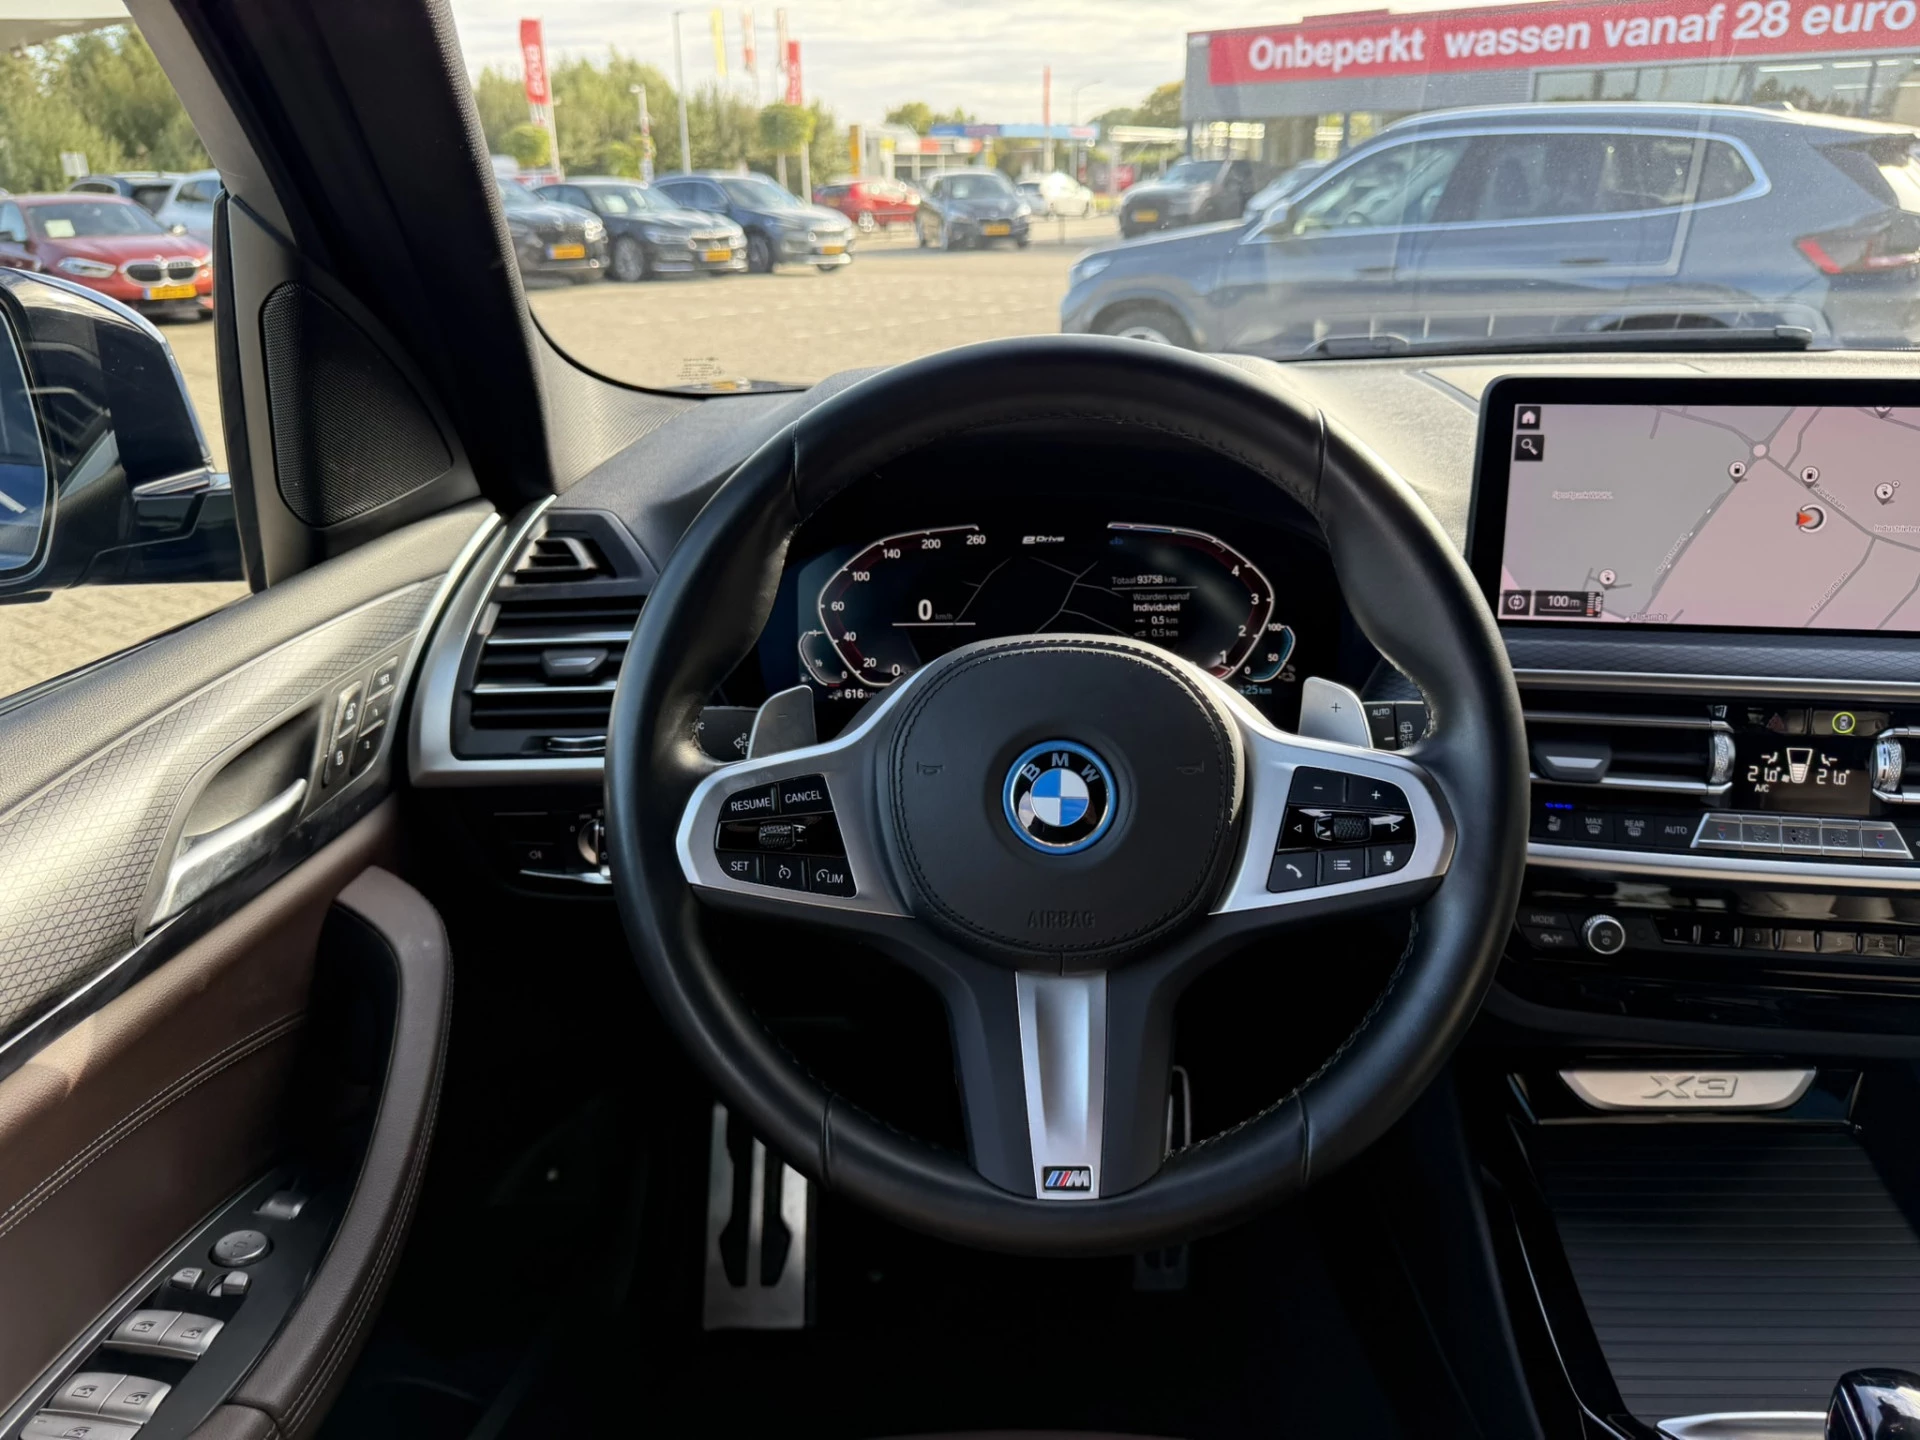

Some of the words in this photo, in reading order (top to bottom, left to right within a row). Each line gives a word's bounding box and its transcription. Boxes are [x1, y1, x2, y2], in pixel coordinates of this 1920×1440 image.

[1249, 27, 1426, 72] Onbeperkt
[1444, 21, 1591, 58] wassen
[1603, 5, 1725, 48] vanaf
[1732, 0, 1790, 39] 28
[1802, 0, 1917, 36] euro
[921, 539, 941, 549] 200
[966, 535, 986, 545] 260
[883, 549, 900, 559] 140
[1231, 565, 1240, 576] 4
[853, 571, 870, 581] 100
[1112, 576, 1136, 585] Totaal
[1137, 575, 1163, 585] 93758
[1164, 576, 1177, 584] km
[1133, 593, 1166, 601] Waarden
[1168, 592, 1190, 601] vanaf
[1251, 594, 1259, 605] 3
[1548, 596, 1568, 607] 100
[1569, 599, 1580, 607] m
[831, 601, 844, 611] 60
[918, 599, 932, 621] 0
[1133, 603, 1180, 612] Individueel
[1151, 616, 1164, 625] 0.5
[1165, 616, 1178, 625] km
[1238, 626, 1246, 637] 2
[1267, 623, 1282, 631] 100
[843, 631, 856, 641] 40
[1151, 629, 1164, 638] 0.5
[1165, 629, 1178, 638] km
[1220, 650, 1227, 664] 1
[1268, 654, 1278, 662] 50
[863, 657, 876, 668] 20
[891, 664, 900, 676] 0
[1244, 666, 1251, 675] 0
[844, 688, 864, 699] 616
[1245, 686, 1259, 695] 25
[1372, 708, 1390, 716] AUTO
[1021, 752, 1100, 783] BMW
[1754, 783, 1769, 793] A/C
[785, 790, 822, 804] CANCEL
[731, 796, 771, 812] RESUME
[1585, 816, 1603, 825] MAX
[1624, 819, 1645, 828] REAR
[1664, 826, 1688, 835] AUTO
[731, 861, 749, 872] SET
[826, 873, 844, 885] LIM
[1027, 909, 1096, 929] AIRBAG
[1530, 914, 1555, 925] MODE
[1640, 1075, 1739, 1099] X3
